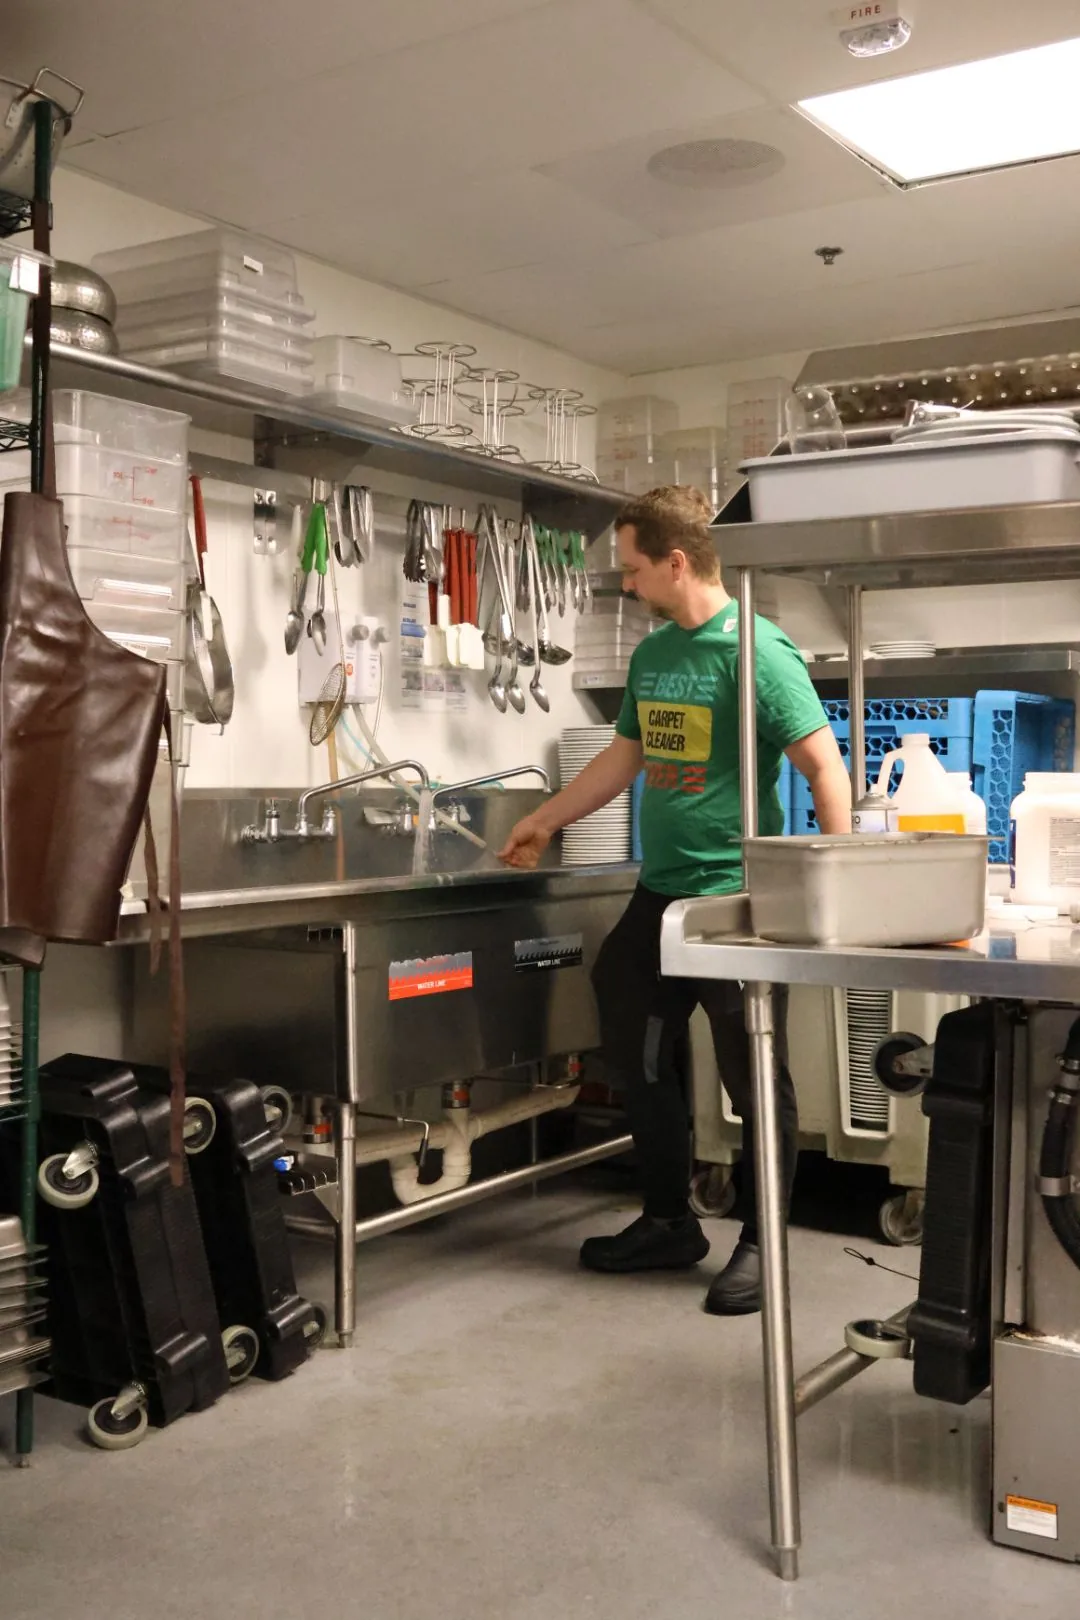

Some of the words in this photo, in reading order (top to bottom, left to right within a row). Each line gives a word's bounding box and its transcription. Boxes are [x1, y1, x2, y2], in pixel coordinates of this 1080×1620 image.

[850, 5, 881, 20] FIRE
[653, 672, 698, 698] BEST
[648, 709, 686, 729] CARPET
[646, 731, 686, 752] CLEANER
[537, 960, 552, 968] WATER
[552, 958, 561, 966] LINE
[417, 981, 435, 991] WATER
[436, 979, 447, 988] LINE
